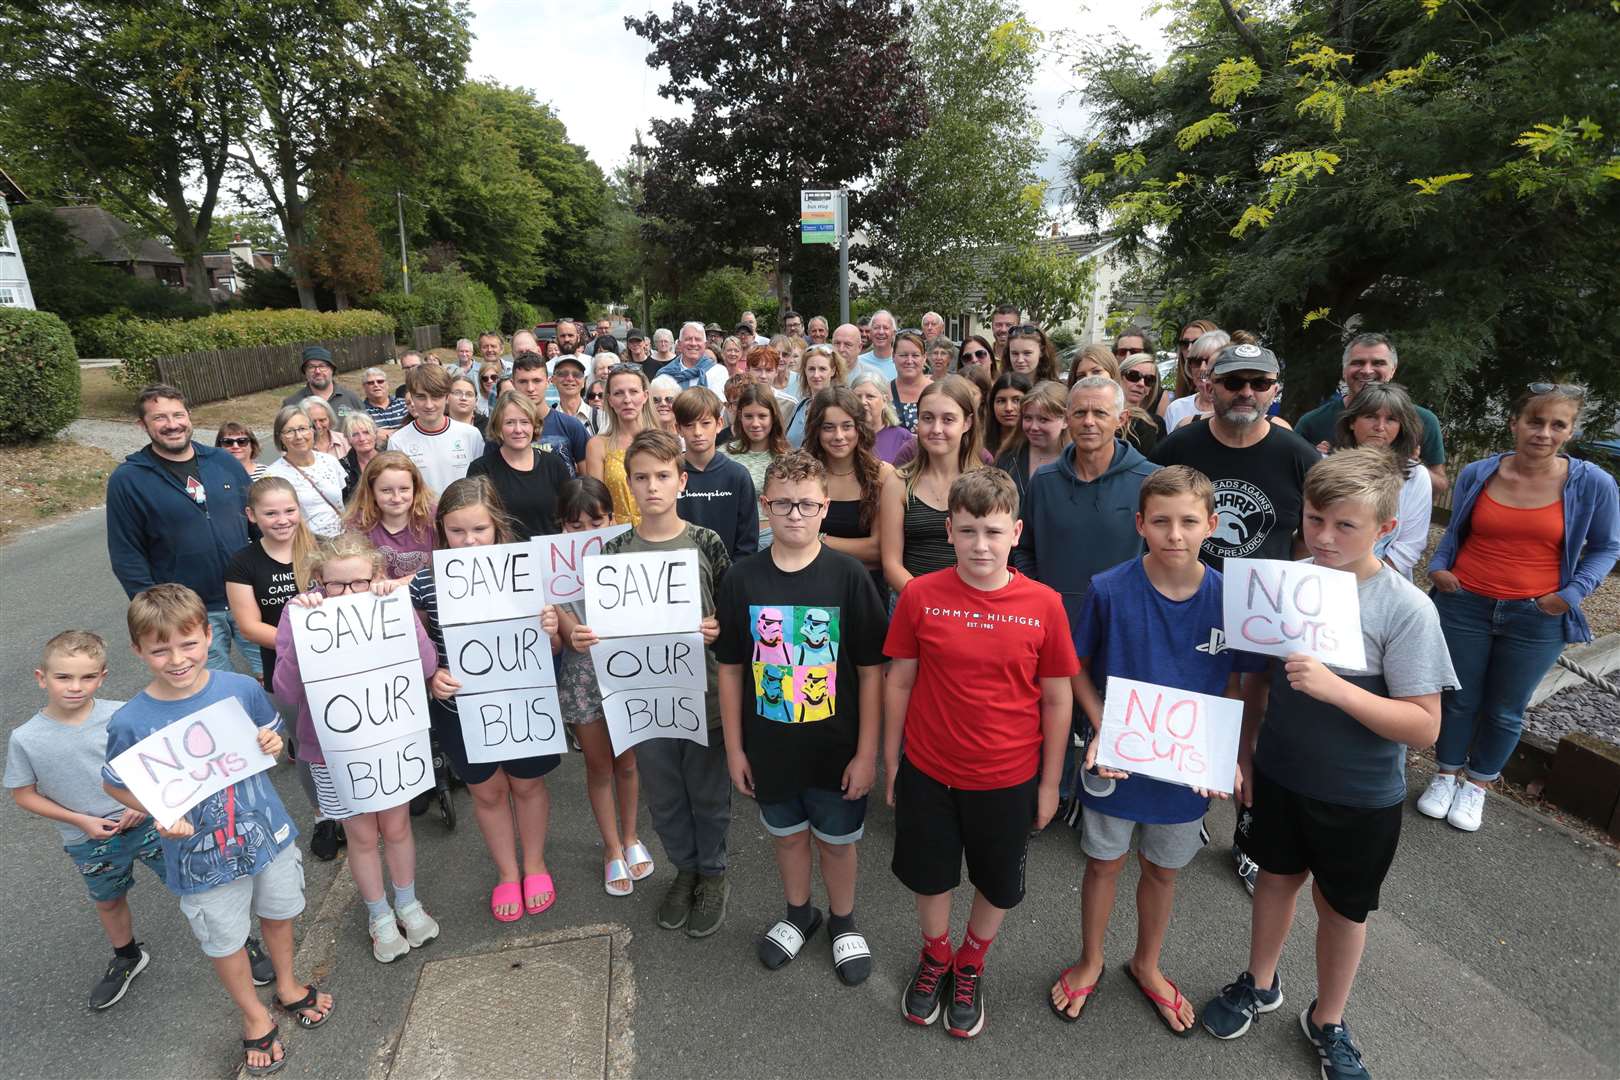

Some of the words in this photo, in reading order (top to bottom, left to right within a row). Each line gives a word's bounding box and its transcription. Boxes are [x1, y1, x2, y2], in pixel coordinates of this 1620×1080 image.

[1213, 481, 1239, 489] EADS
[1241, 484, 1273, 514] AGAINST
[1215, 493, 1257, 515] HARP
[1218, 531, 1265, 556] PREJUDICE
[268, 584, 296, 594] CARE
[445, 552, 534, 599] SAVE
[596, 560, 691, 609] SAVE
[1247, 568, 1321, 615] NO
[305, 598, 406, 654] SAVE
[924, 606, 970, 618] TOMMY
[987, 613, 1040, 628] HILFIGER
[459, 627, 542, 676] OUR
[606, 641, 694, 678] OUR
[323, 675, 416, 733] OUR
[479, 697, 556, 747] BUS
[624, 696, 700, 734] BUS
[1124, 688, 1198, 740] NO
[138, 720, 216, 784] NO
[346, 741, 426, 801] BUS
[776, 927, 795, 943] ACK
